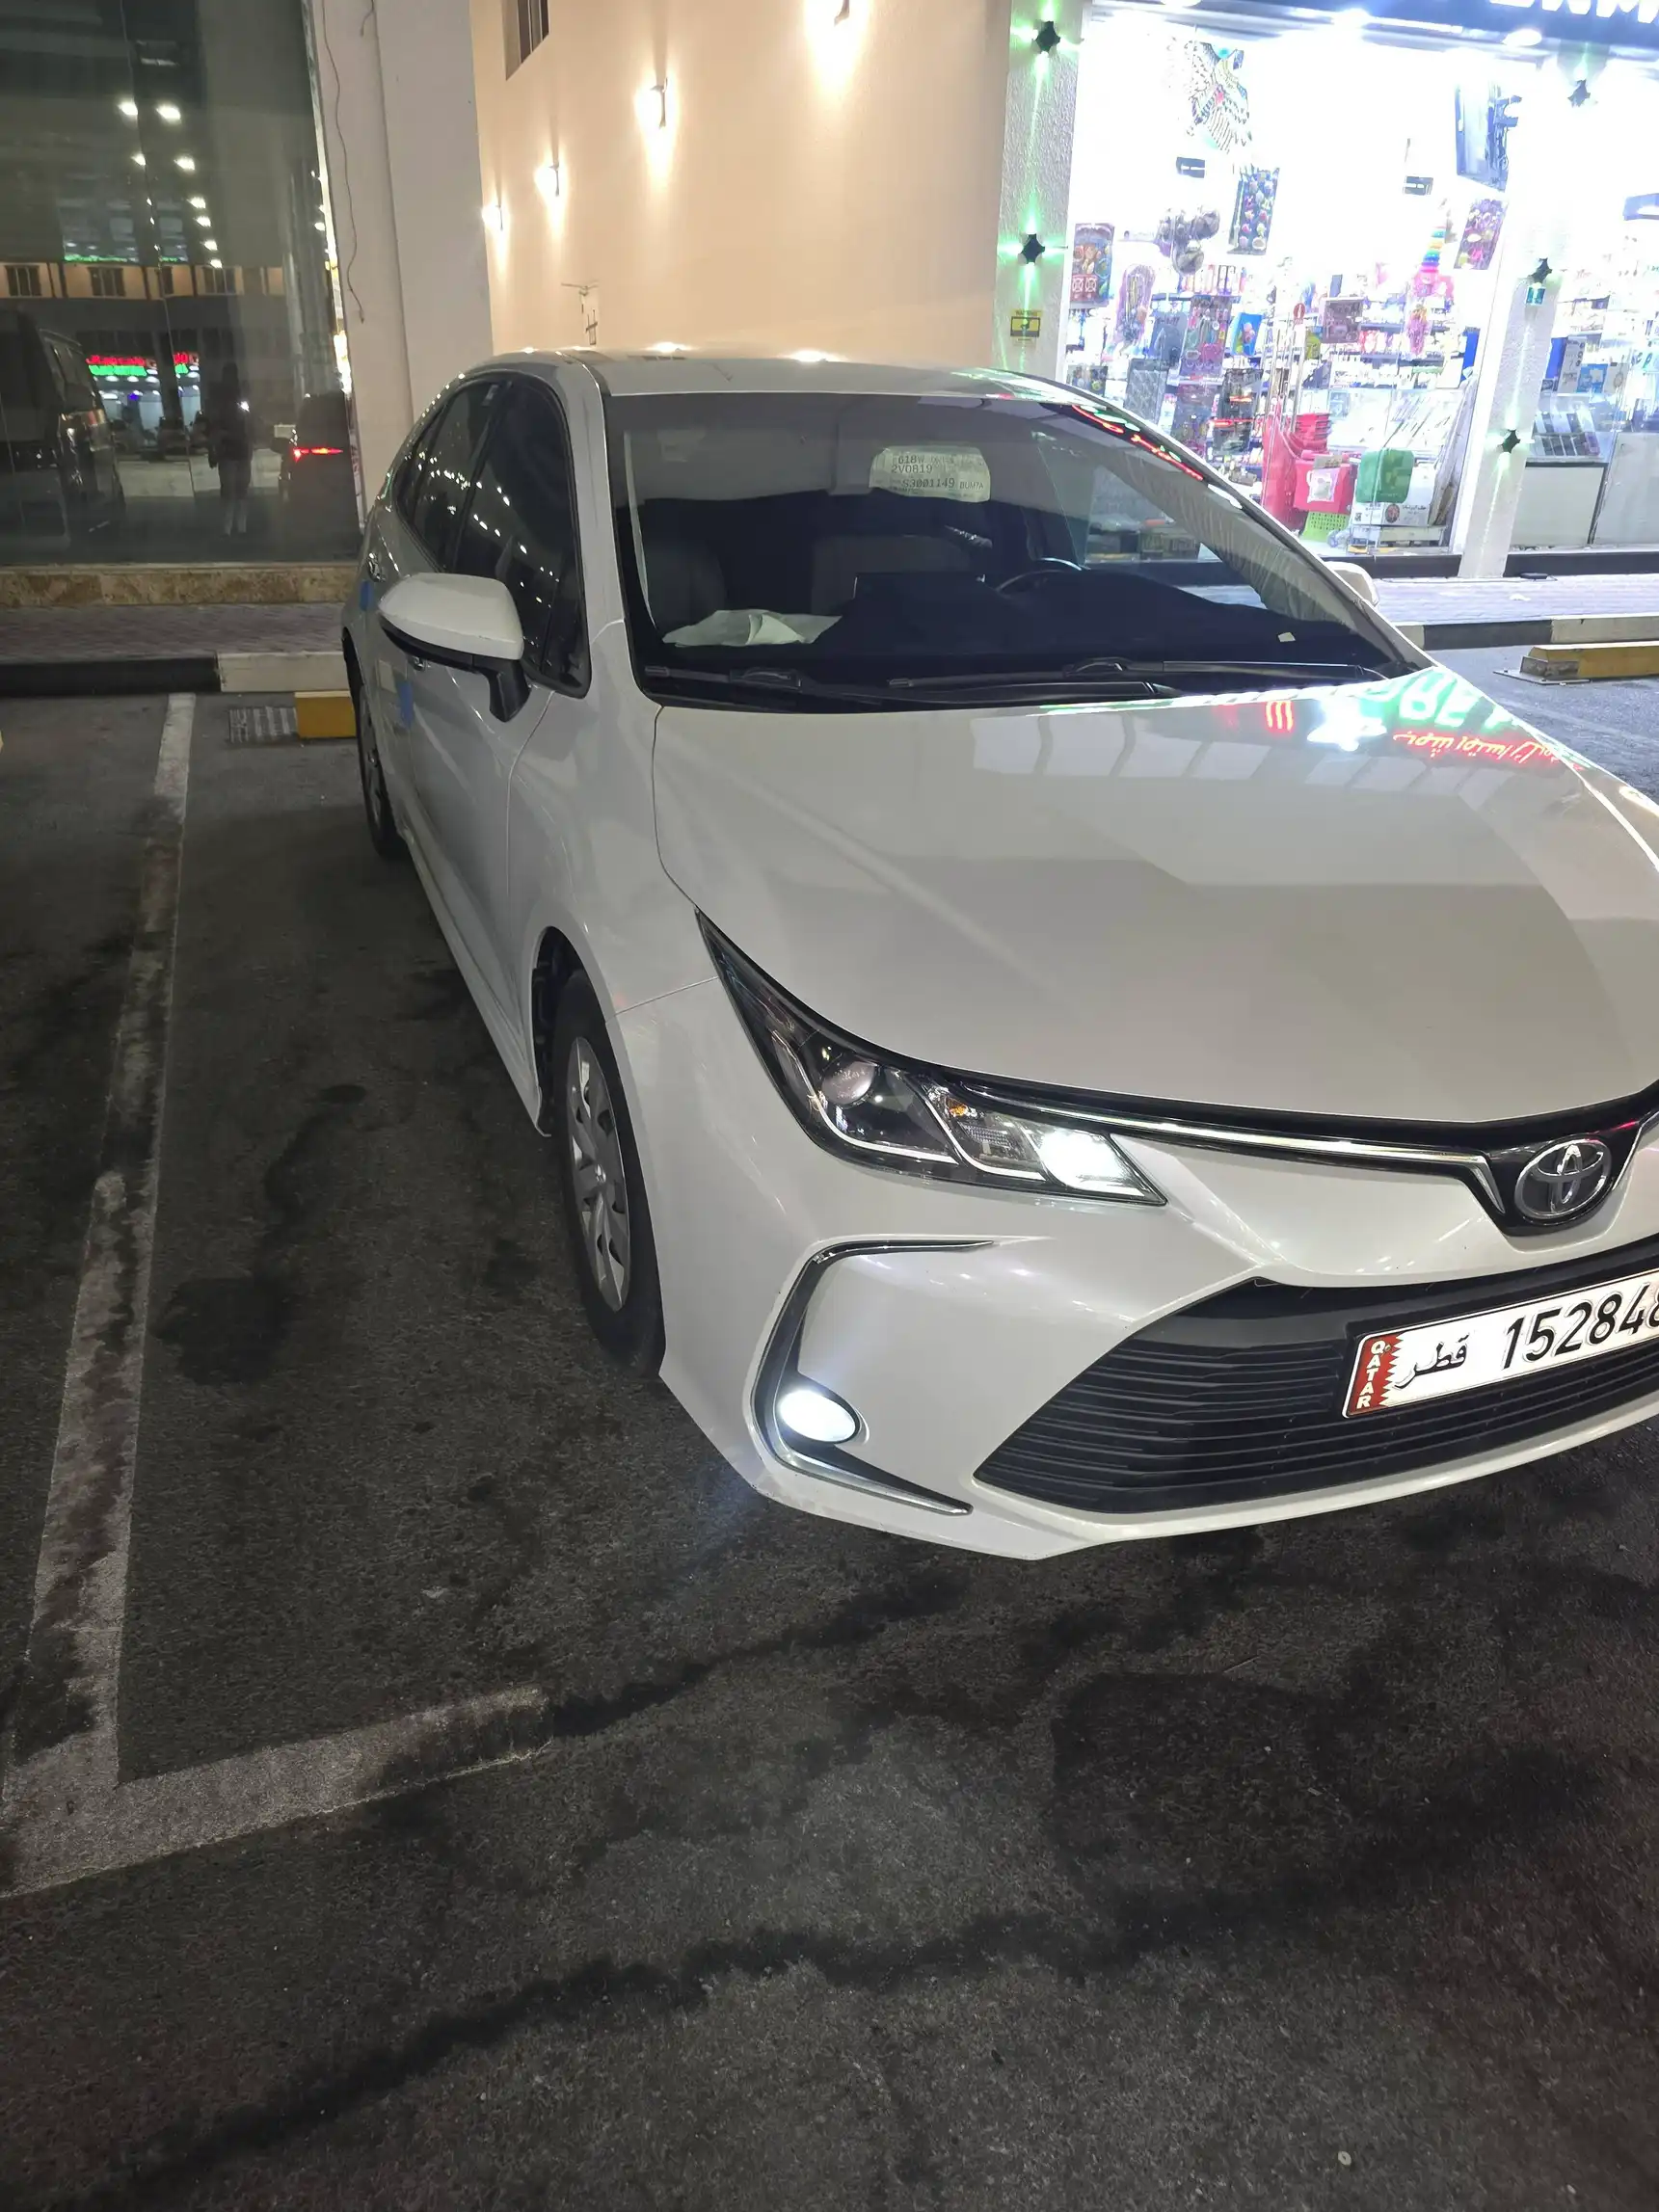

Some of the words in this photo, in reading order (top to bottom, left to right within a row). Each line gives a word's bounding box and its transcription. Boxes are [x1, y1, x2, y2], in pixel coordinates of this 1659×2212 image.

[1356, 1340, 1385, 1409] QATAR
[1394, 1334, 1469, 1389] قطر
[1502, 1283, 1659, 1370] 15284
